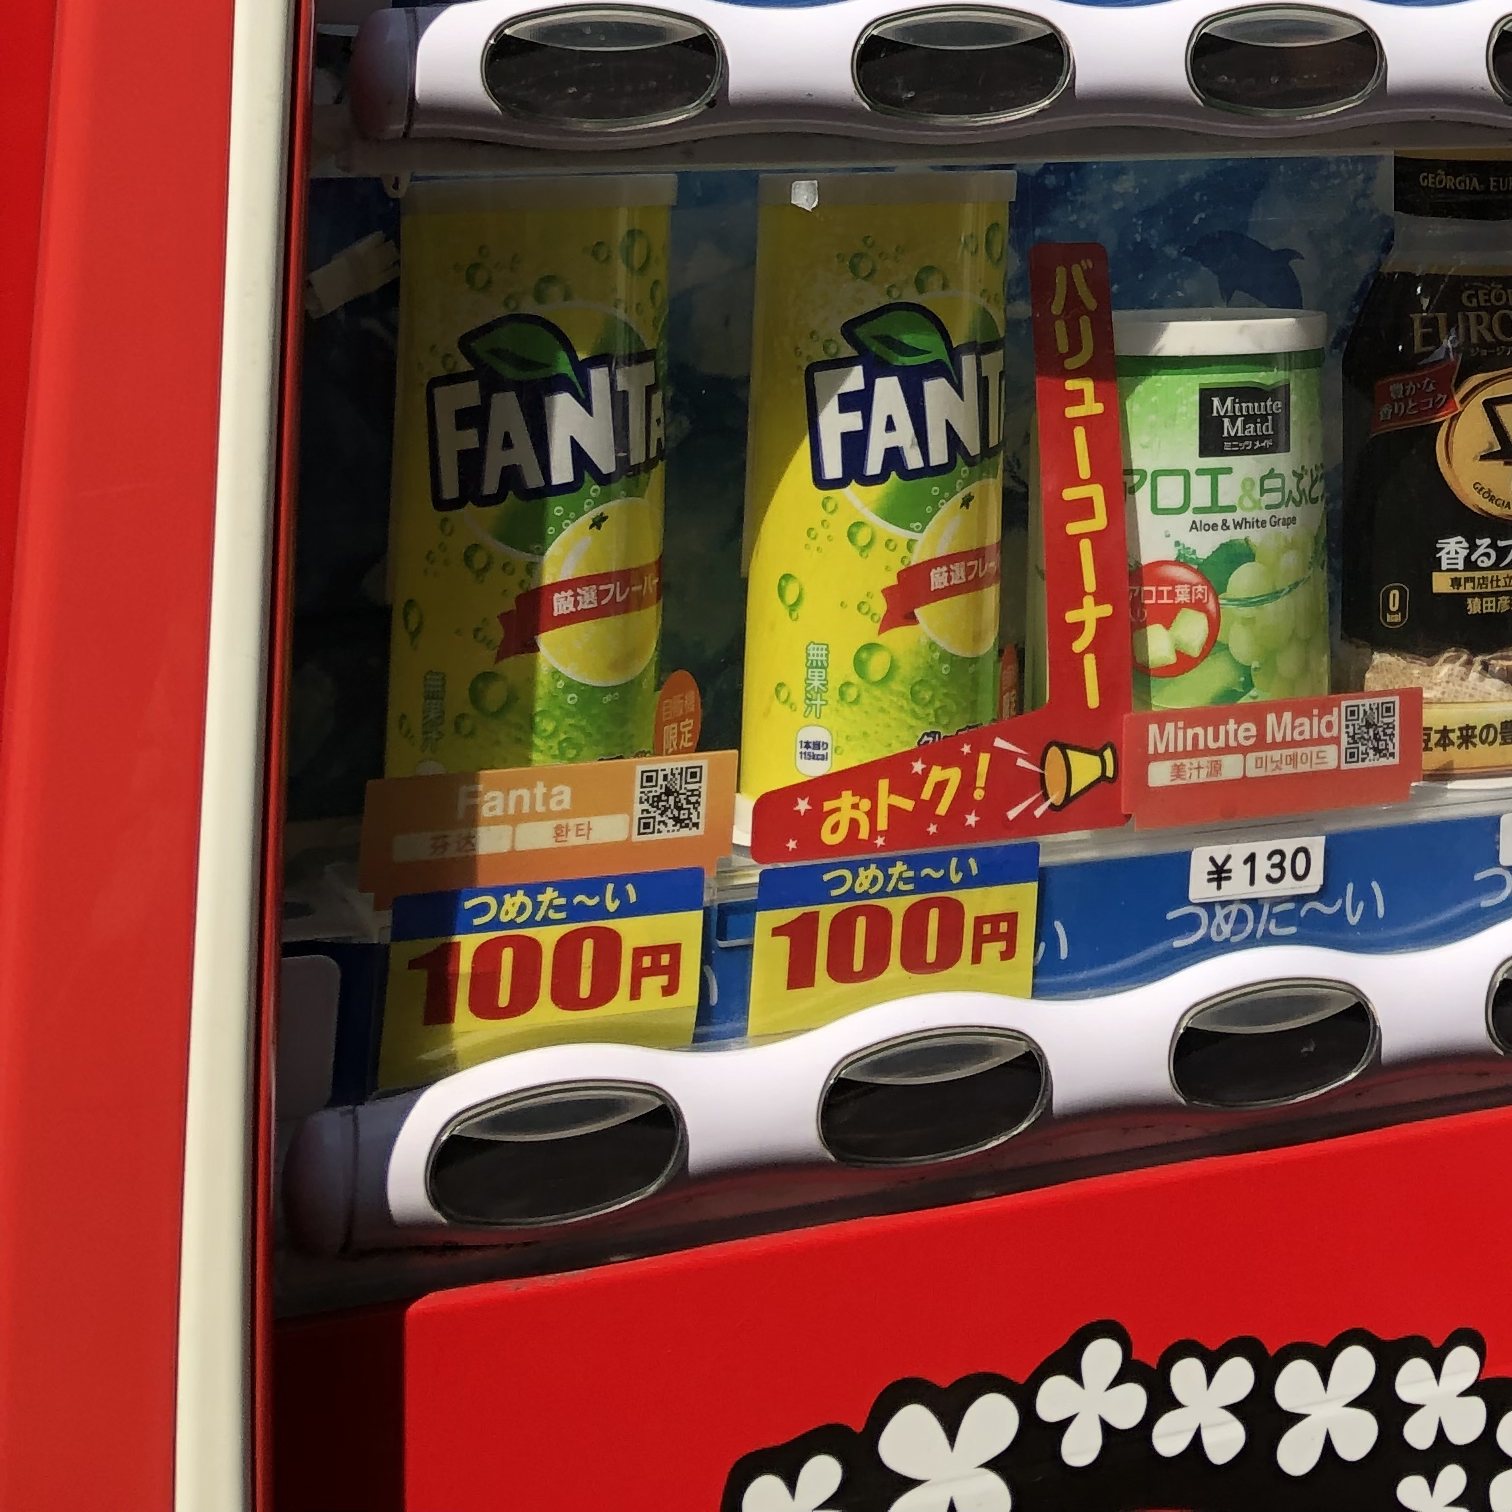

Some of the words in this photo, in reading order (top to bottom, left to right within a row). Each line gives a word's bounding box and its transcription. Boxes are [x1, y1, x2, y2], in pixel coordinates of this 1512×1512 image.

[1210, 394, 1283, 418] Minute
[1221, 417, 1274, 438] Maid
[1051, 259, 1114, 710] バリューコーナー
[1188, 519, 1218, 534] Aloe
[1219, 517, 1231, 531] &
[1231, 516, 1267, 531] White
[1268, 514, 1297, 530] Grape
[803, 641, 829, 718] 無果汁
[1146, 715, 1257, 756] Minute
[1265, 707, 1340, 746] Maid
[1169, 759, 1223, 783] 美汁源
[1252, 749, 1330, 775] 미닛메이드
[456, 780, 572, 819] Fanta
[820, 750, 990, 847] おトク!
[552, 821, 593, 844] 환타
[1205, 845, 1313, 889] ¥130
[770, 896, 1019, 992] 100円
[407, 924, 683, 1027] 100円
